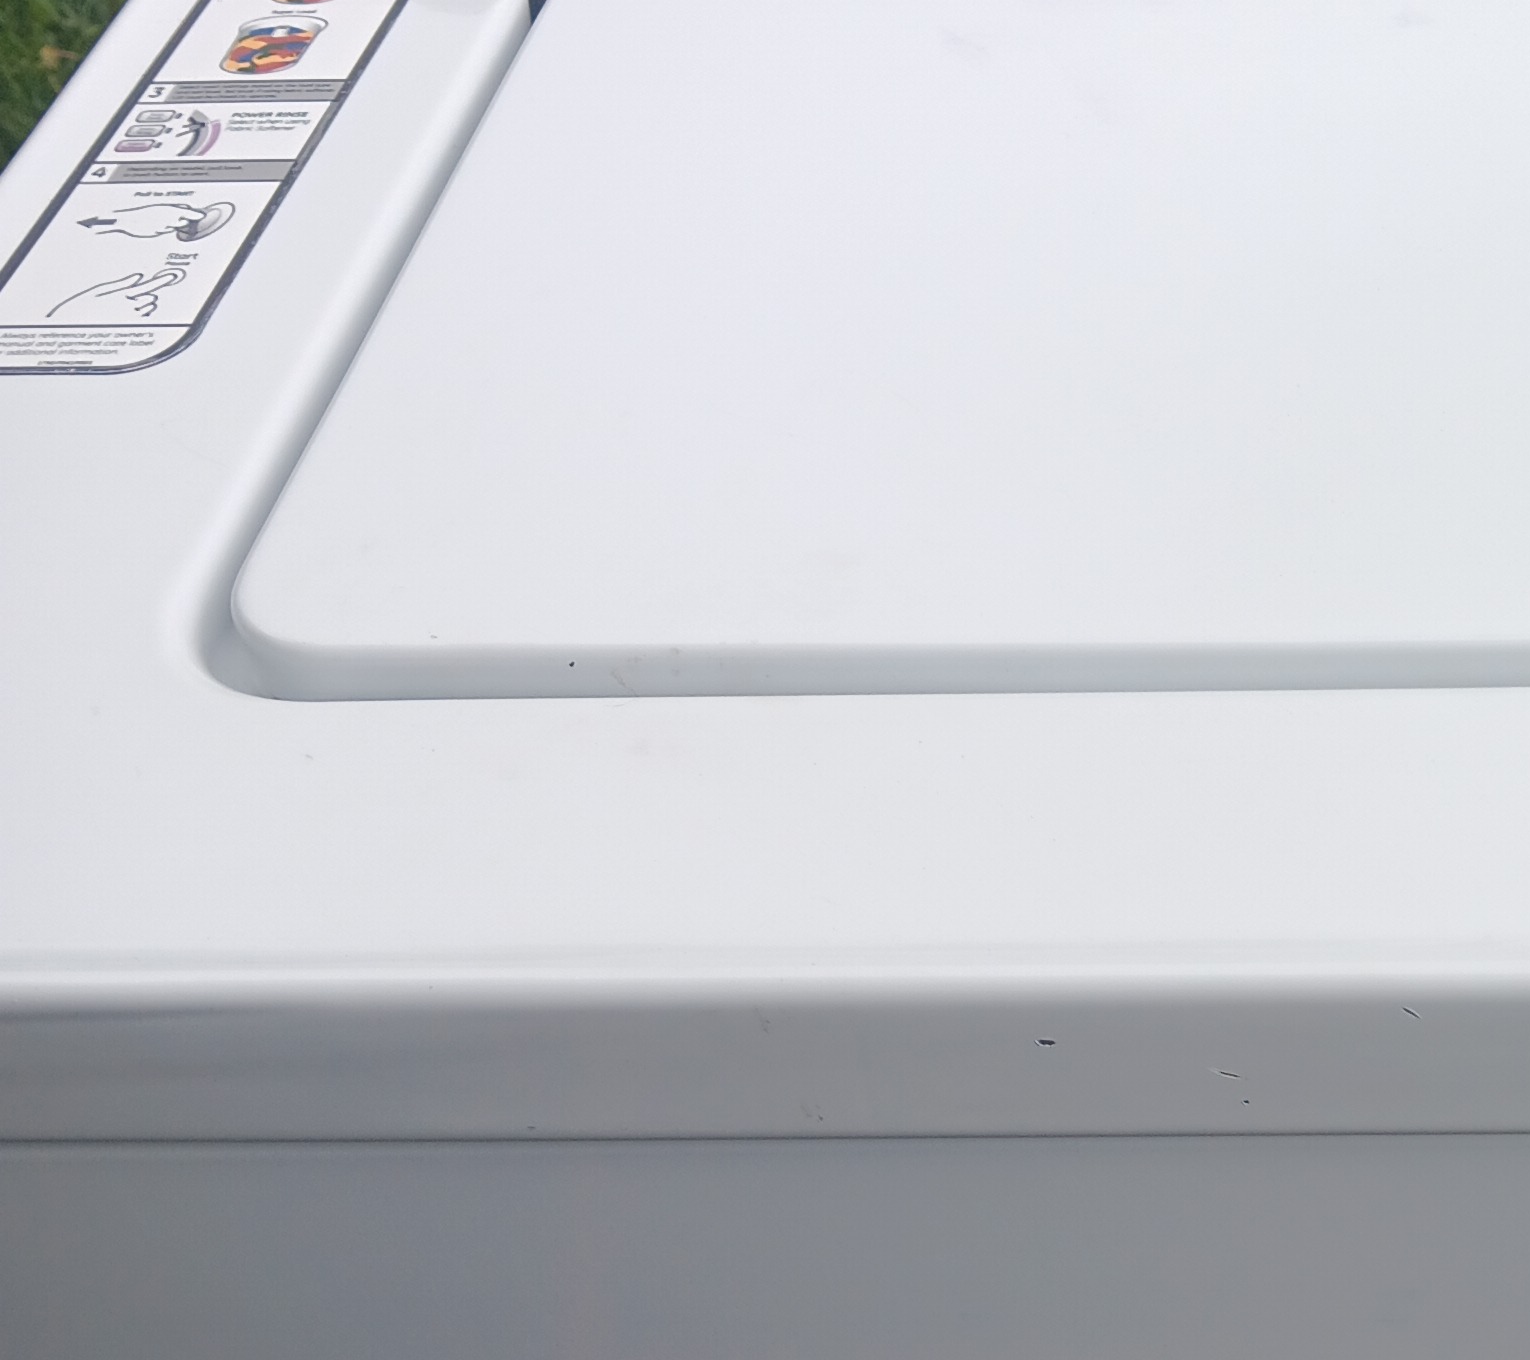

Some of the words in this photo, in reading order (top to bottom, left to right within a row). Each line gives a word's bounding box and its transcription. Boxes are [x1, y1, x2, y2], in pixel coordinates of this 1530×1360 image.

[149, 86, 166, 98] 3
[91, 167, 106, 177] 4
[166, 252, 199, 260] Start
